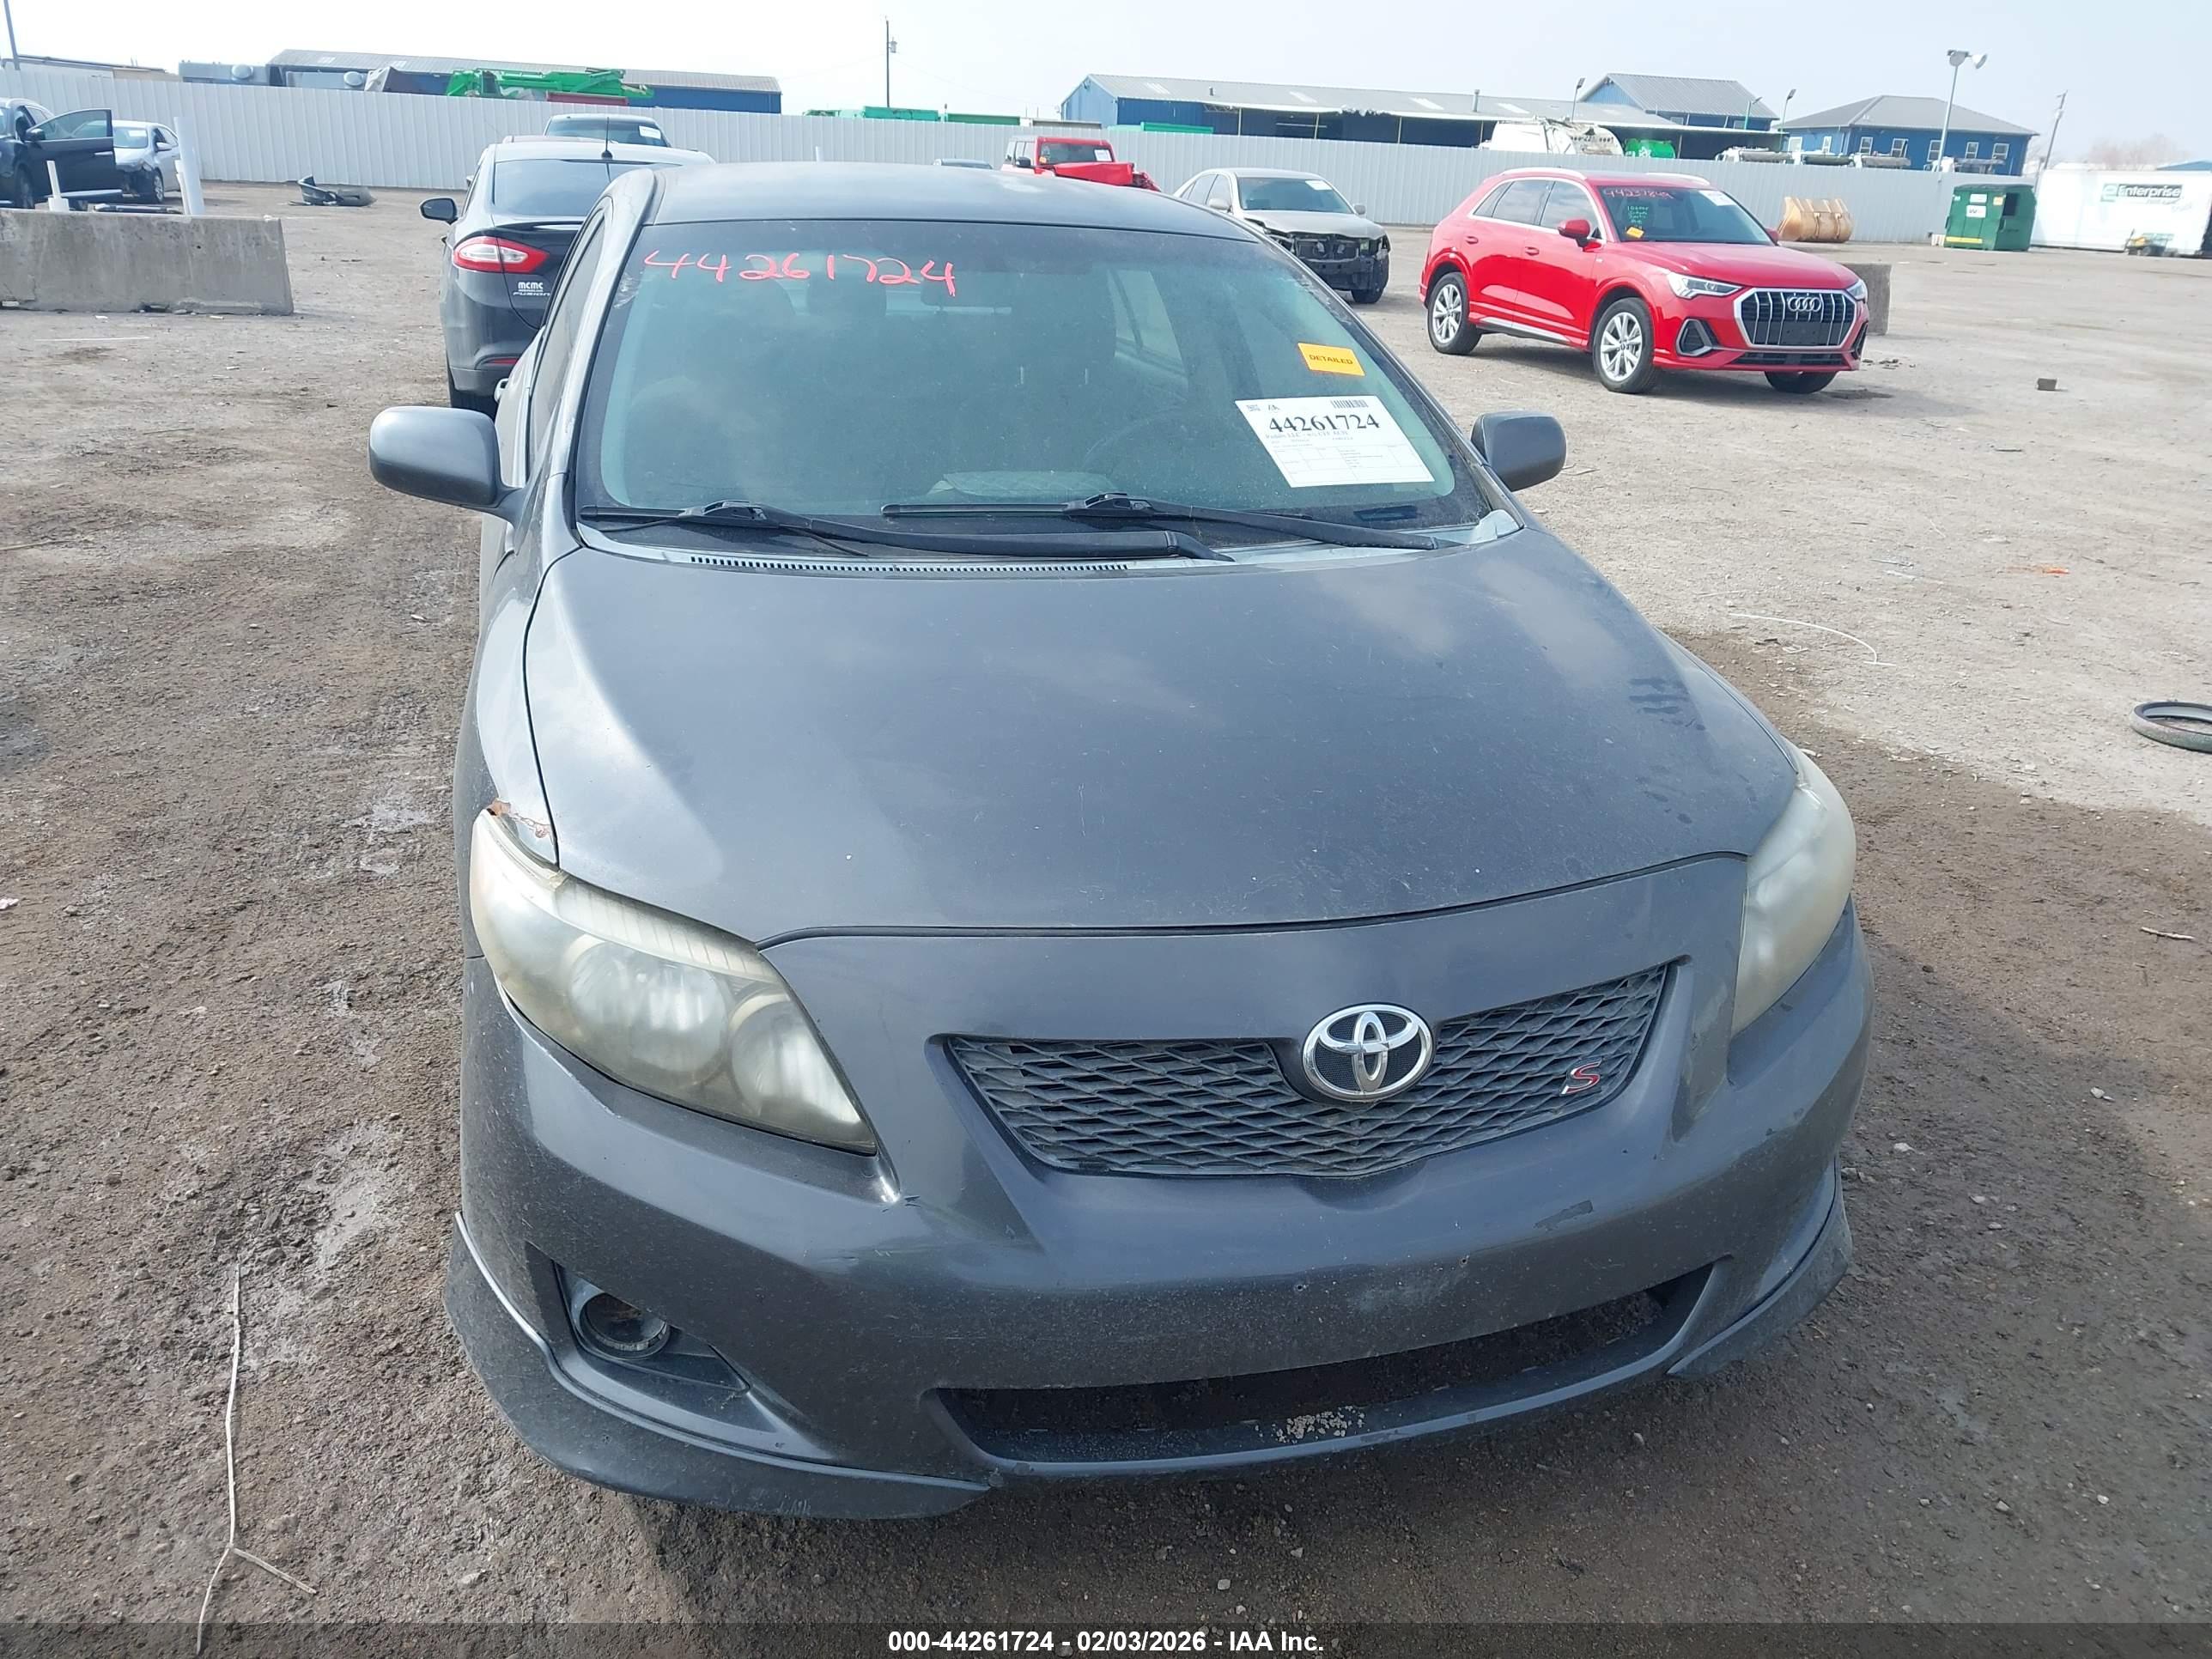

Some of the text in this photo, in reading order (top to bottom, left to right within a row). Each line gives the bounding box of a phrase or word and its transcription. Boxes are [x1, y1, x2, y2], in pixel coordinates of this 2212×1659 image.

[2118, 185, 2181, 198] Enterprise
[644, 249, 956, 297] 44261724
[1309, 354, 1353, 365] DETAILED
[1269, 413, 1381, 433] 44261724
[1560, 1059, 1602, 1095] S
